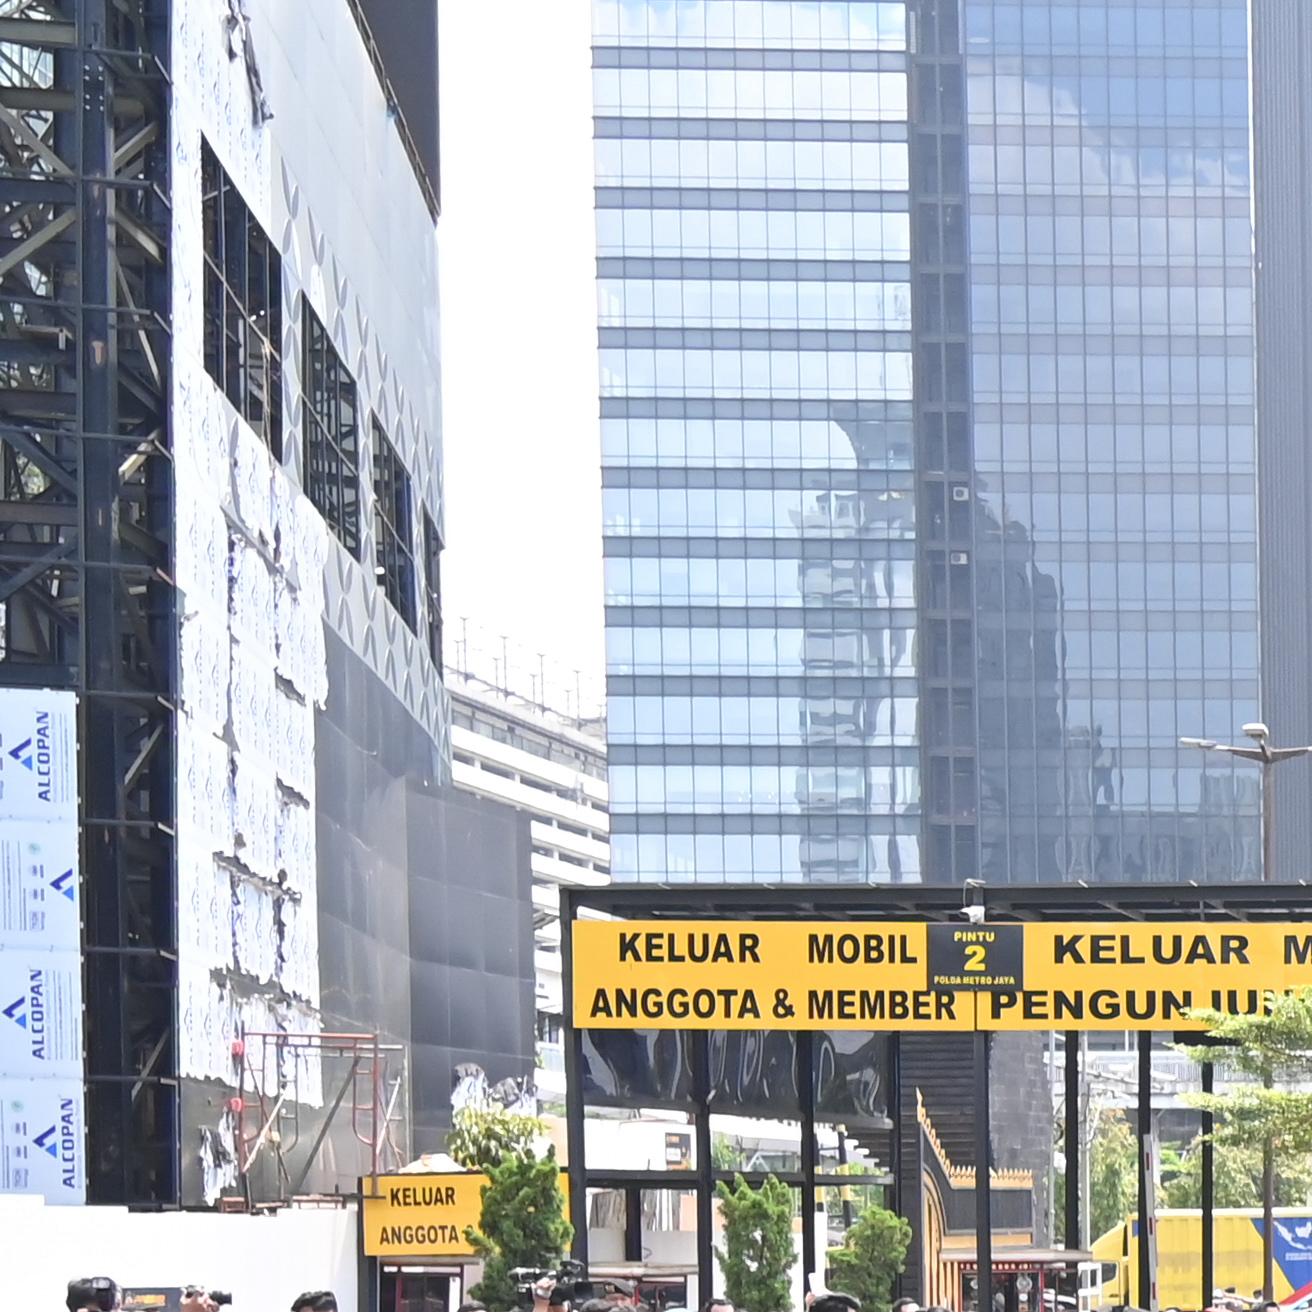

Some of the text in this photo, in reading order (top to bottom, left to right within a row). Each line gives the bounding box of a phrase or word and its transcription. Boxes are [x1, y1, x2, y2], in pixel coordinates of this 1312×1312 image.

[36, 710, 51, 802] ALCOPAN
[618, 932, 918, 964] KELUAR MOBIL
[953, 931, 995, 942] PINTU
[1053, 934, 1250, 965] KELUAR
[963, 944, 986, 971] 2
[933, 975, 1016, 985] POLDA METRO JAYA
[30, 968, 45, 1060] ALCOPAN
[589, 987, 957, 1020] ANGGOTA & MEMBER
[60, 1098, 75, 1189] ALCOPAN
[390, 1186, 456, 1207] KELUAR
[379, 1224, 460, 1245] ANGGOTA
